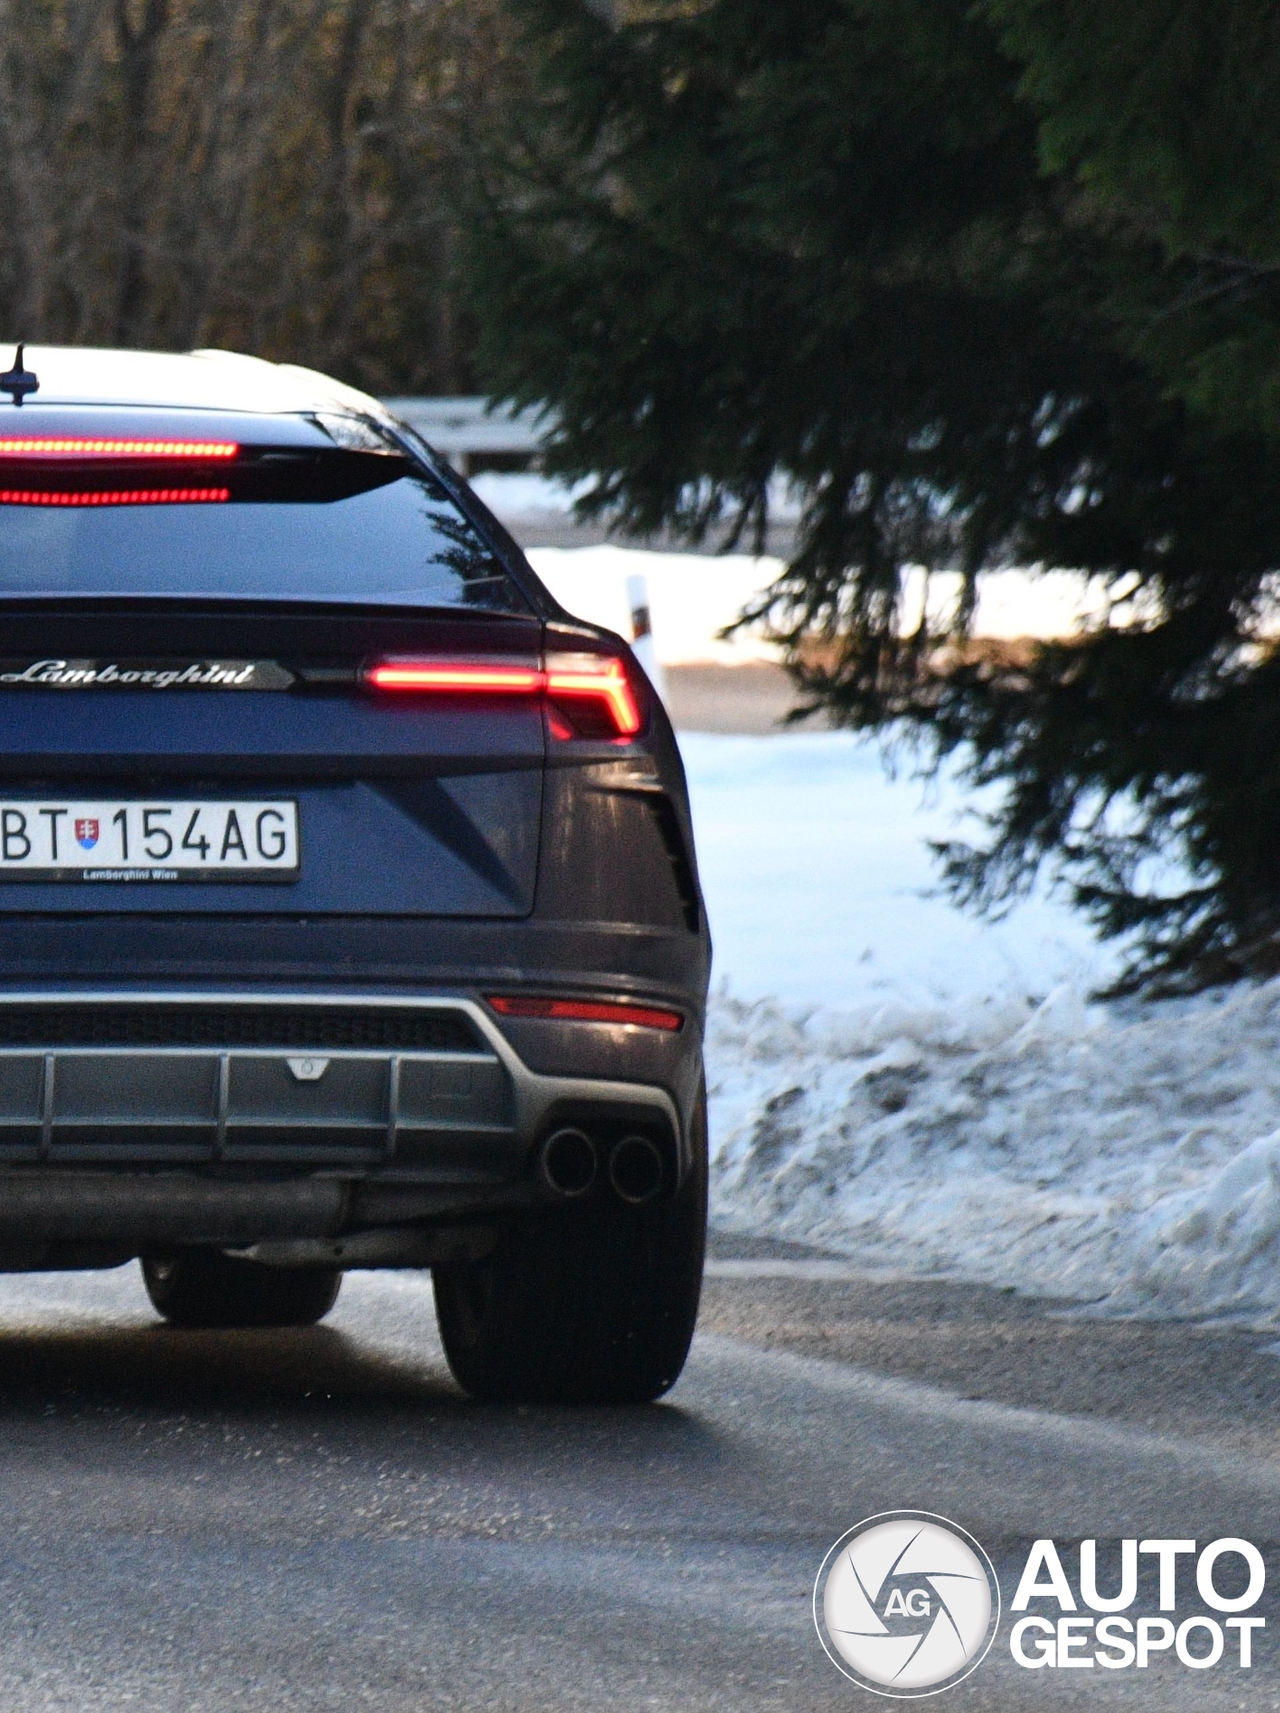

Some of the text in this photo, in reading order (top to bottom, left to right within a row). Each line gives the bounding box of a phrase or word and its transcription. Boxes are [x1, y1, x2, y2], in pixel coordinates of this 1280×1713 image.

[0, 660, 255, 688] Lamborghini
[1, 808, 286, 860] BT 154AG
[83, 869, 178, 881] Lamborghini Wien
